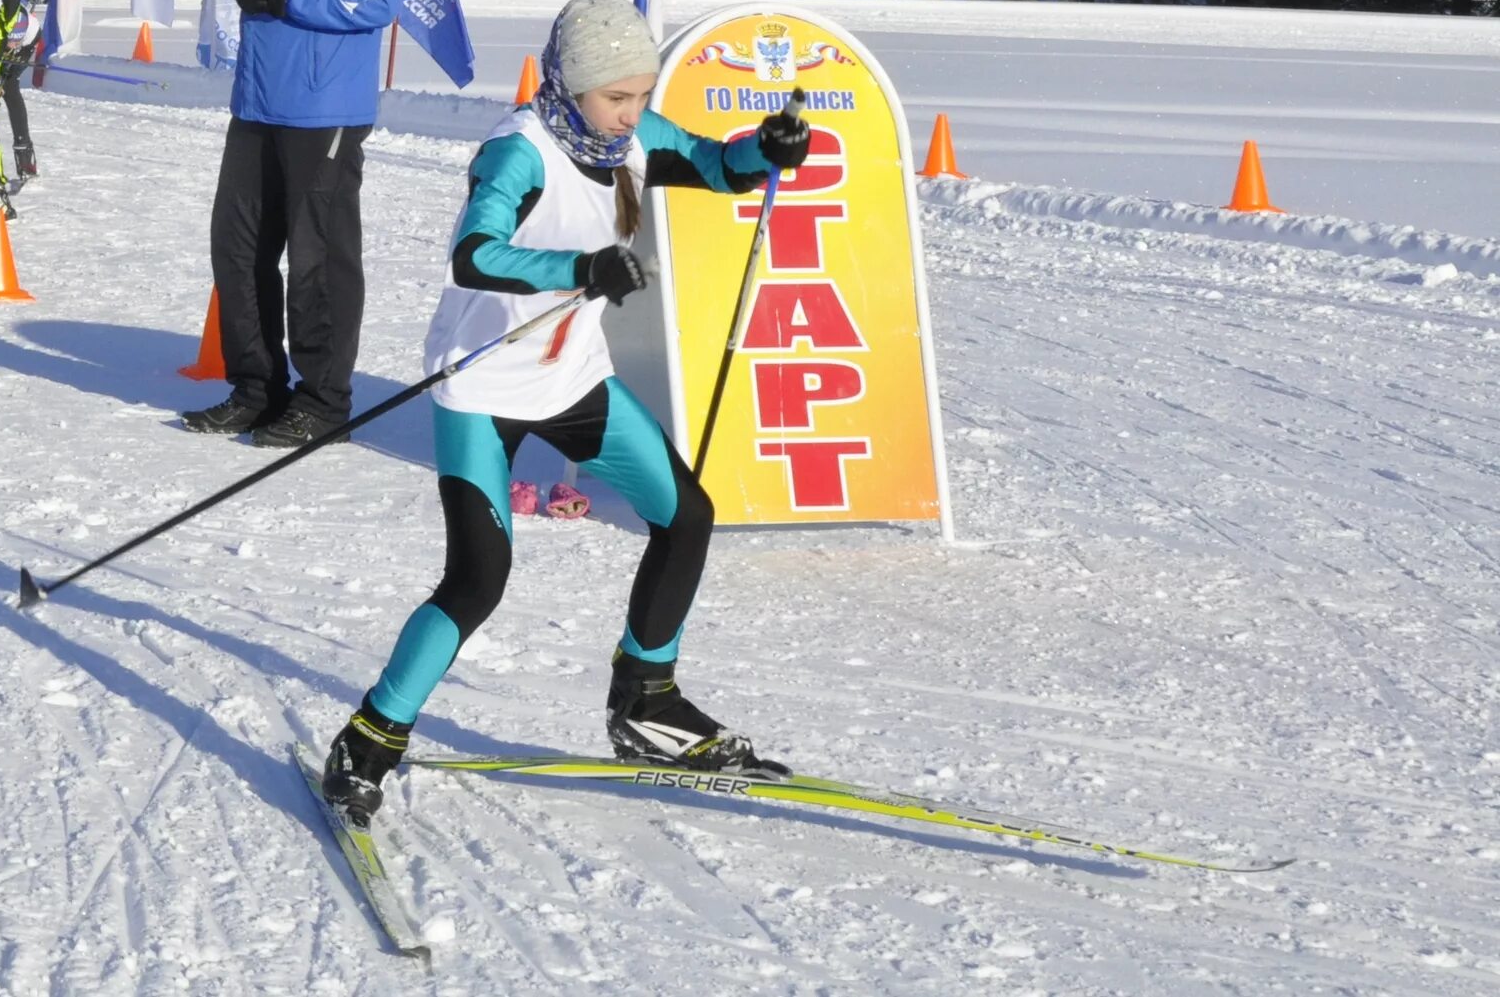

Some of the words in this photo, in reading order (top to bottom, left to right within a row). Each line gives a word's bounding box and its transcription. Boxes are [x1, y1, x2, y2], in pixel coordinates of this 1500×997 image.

[705, 87, 733, 112] ГО
[724, 124, 870, 510] СТАРТ
[634, 770, 751, 795] FISCHER
